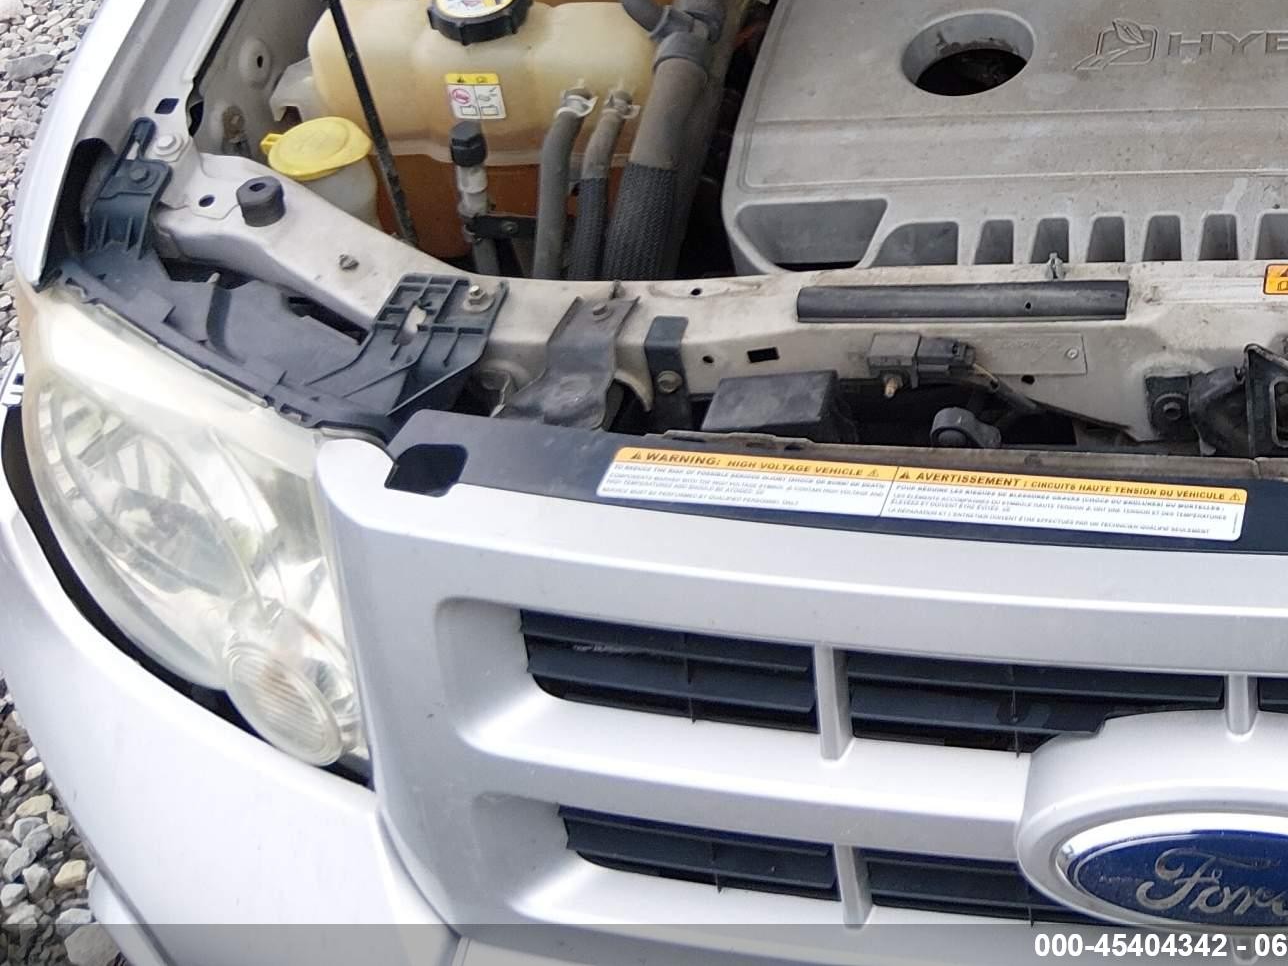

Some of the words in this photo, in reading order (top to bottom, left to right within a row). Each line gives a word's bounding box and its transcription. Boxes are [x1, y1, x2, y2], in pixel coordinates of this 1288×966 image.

[646, 452, 720, 466] WARNING:
[726, 460, 756, 469] HIGH
[760, 461, 810, 473] VOLTAGE
[814, 465, 864, 476] VEHICLE
[916, 471, 1020, 487] AVERTISSEMENT
[1080, 484, 1112, 493] HAUTE
[1115, 486, 1157, 496] TENSION
[1160, 489, 1174, 497] DU
